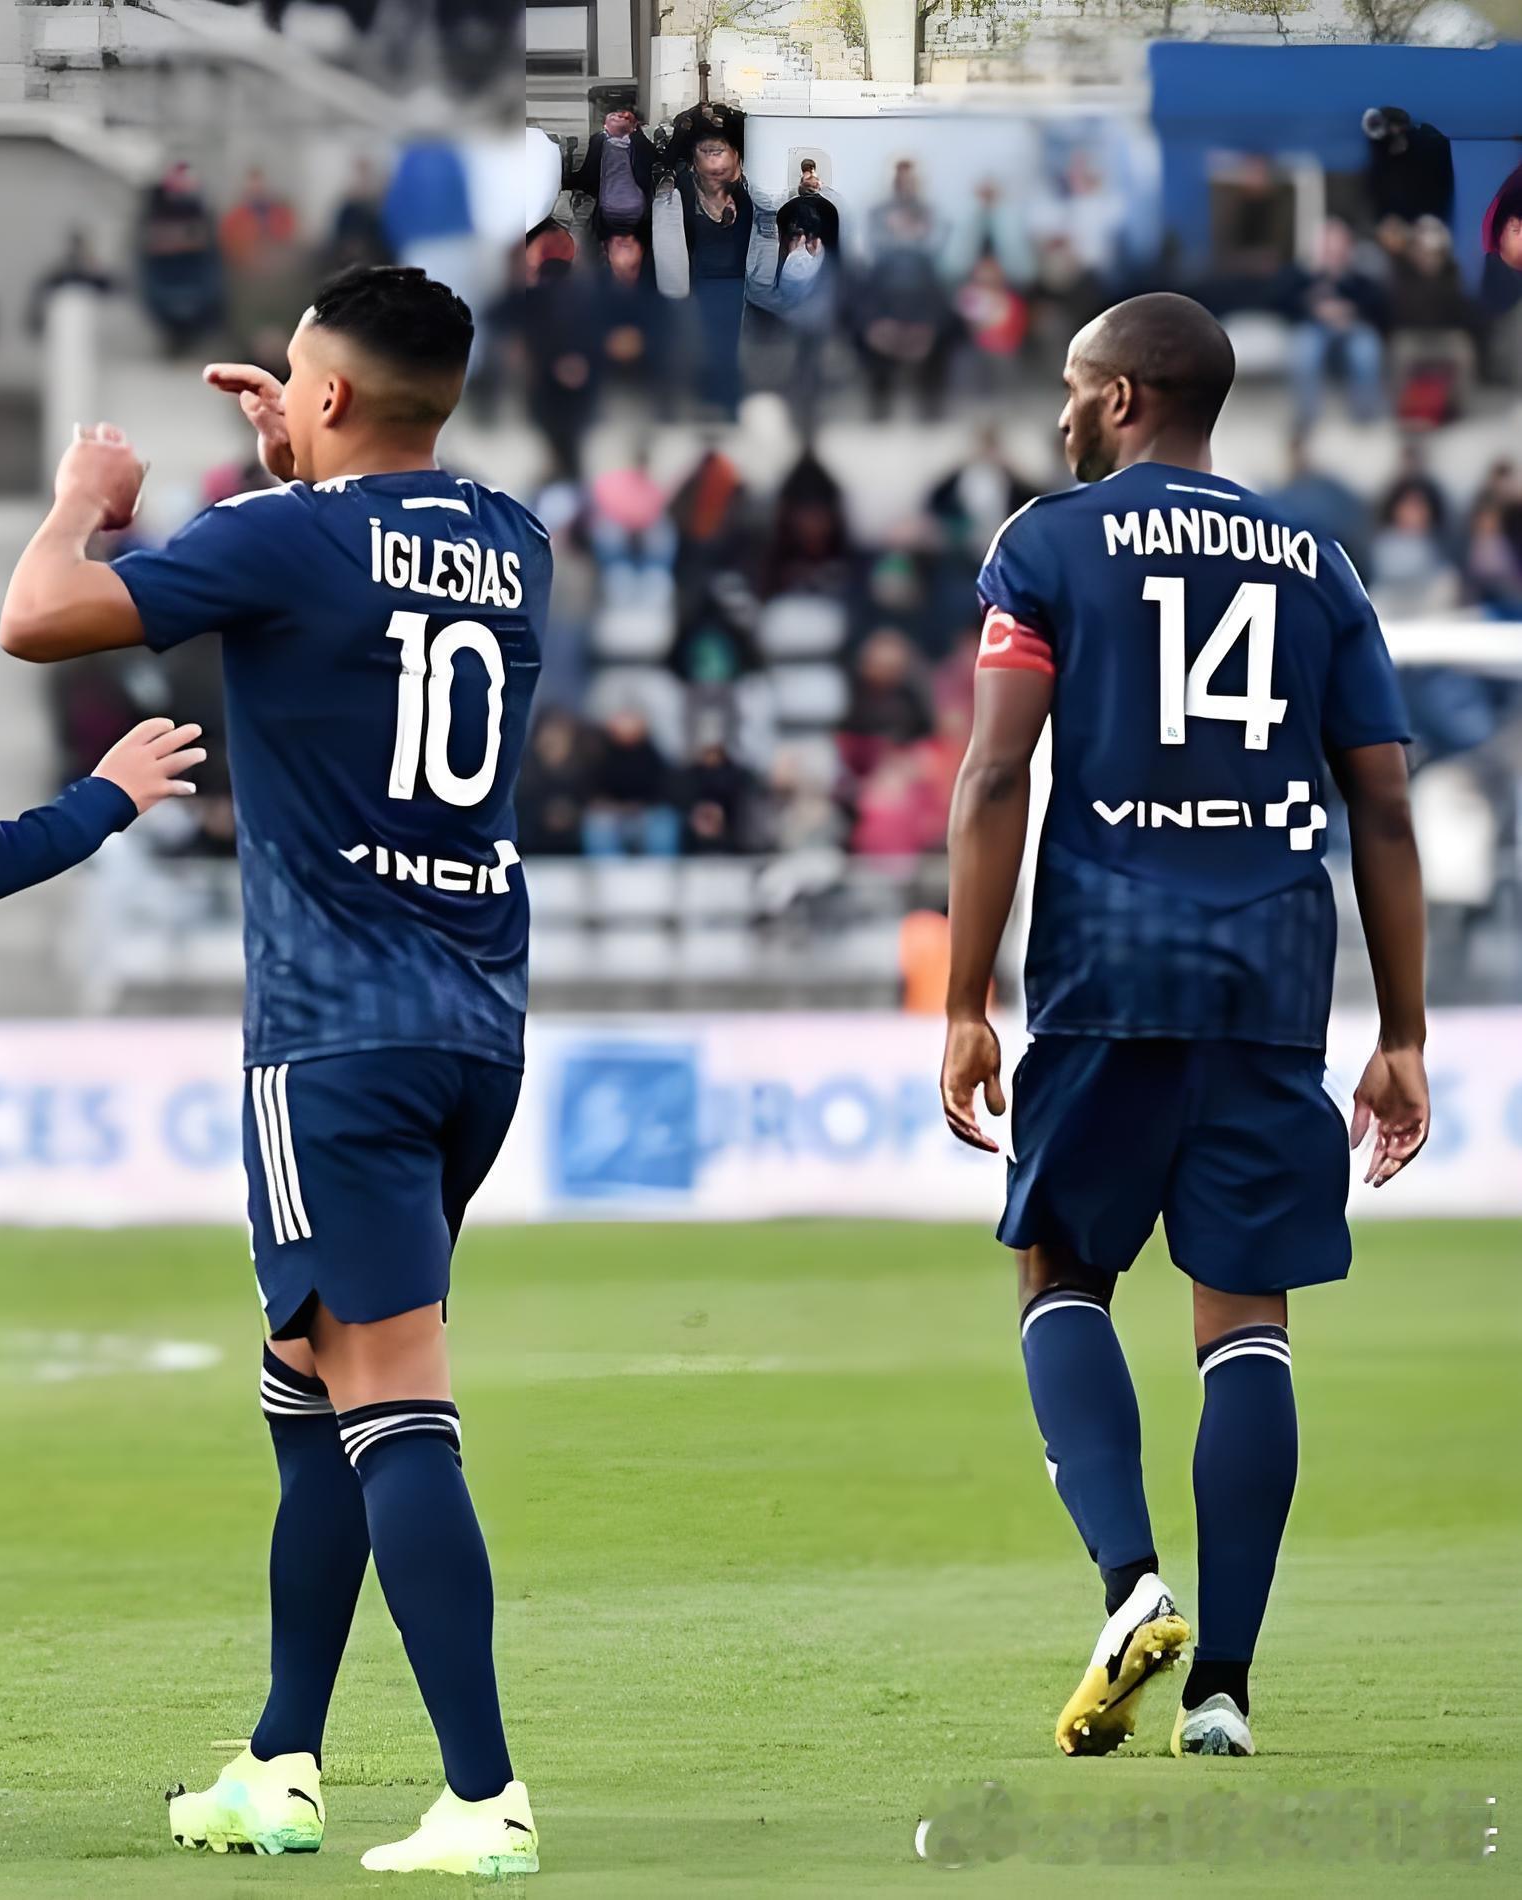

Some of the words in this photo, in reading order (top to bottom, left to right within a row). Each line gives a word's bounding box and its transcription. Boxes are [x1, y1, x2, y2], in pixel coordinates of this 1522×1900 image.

[385, 610, 506, 807] 10
[1142, 575, 1288, 750] 14
[1092, 799, 1253, 829] VINCI
